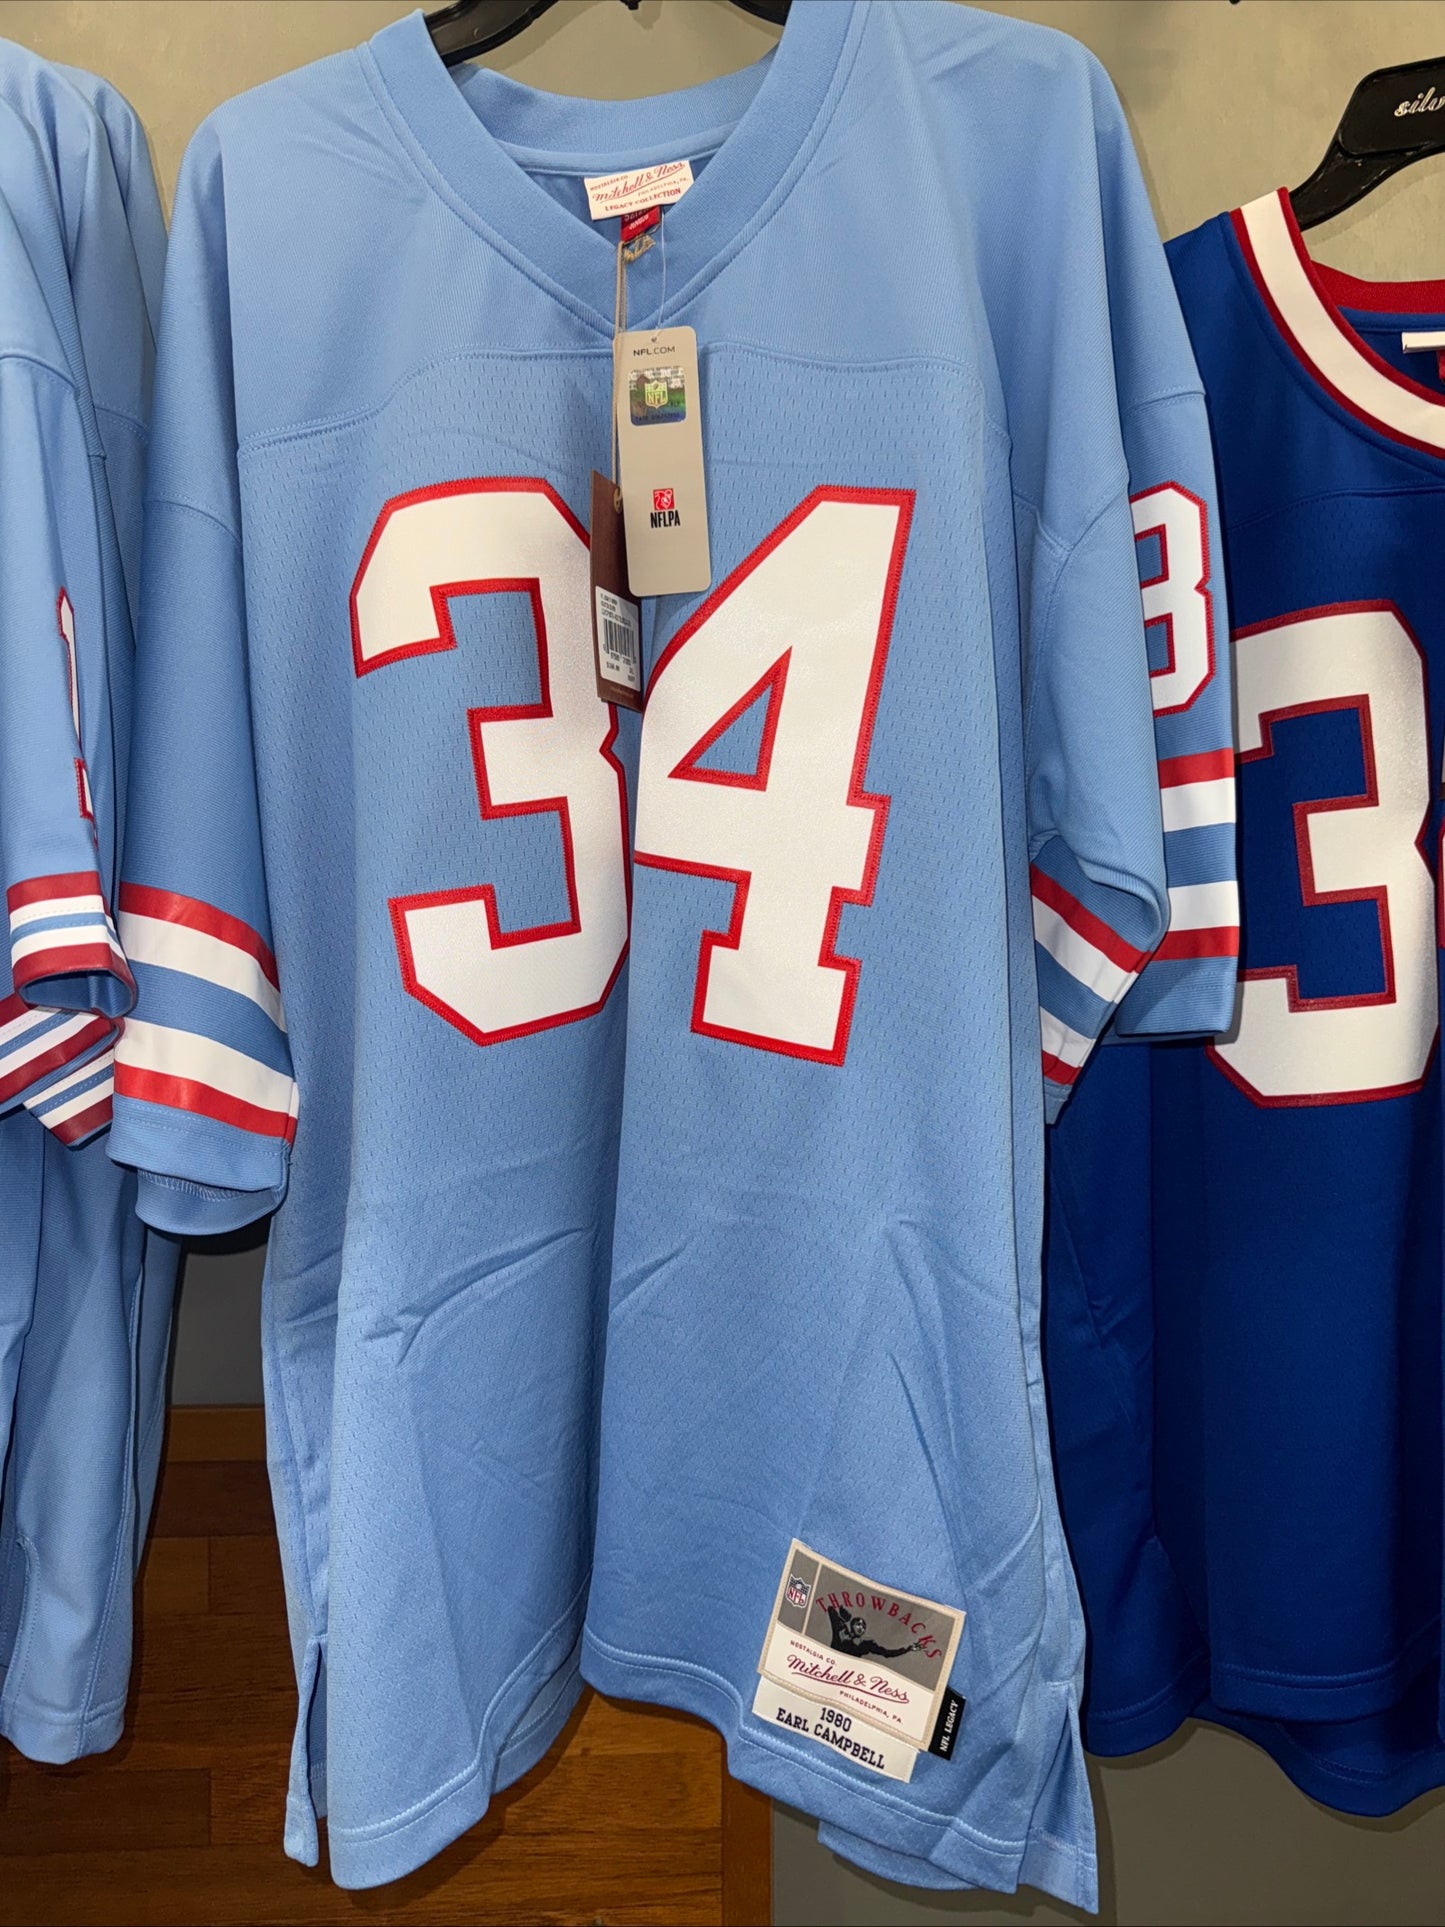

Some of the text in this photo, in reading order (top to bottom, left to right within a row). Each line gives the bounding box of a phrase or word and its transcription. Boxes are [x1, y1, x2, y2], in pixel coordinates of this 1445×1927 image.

[592, 162, 685, 201] Mitchell & Ness
[605, 187, 681, 212] LEGACY COLLECTION
[633, 346, 675, 357] NFL.COM
[647, 391, 666, 404] NFL
[650, 510, 680, 528] NFLPA
[350, 476, 916, 1067] 34
[788, 1586, 806, 1605] NFL
[816, 1591, 943, 1660] THROWBACKS
[790, 1640, 824, 1660] NOSTALGIA
[787, 1654, 909, 1702] Mitchell & Ness
[839, 1690, 889, 1718] PHILADELPHIA,
[820, 1707, 852, 1732] 1980
[939, 1699, 958, 1752] NFL LEGACY
[776, 1707, 885, 1769] EARL CAMPBELL
